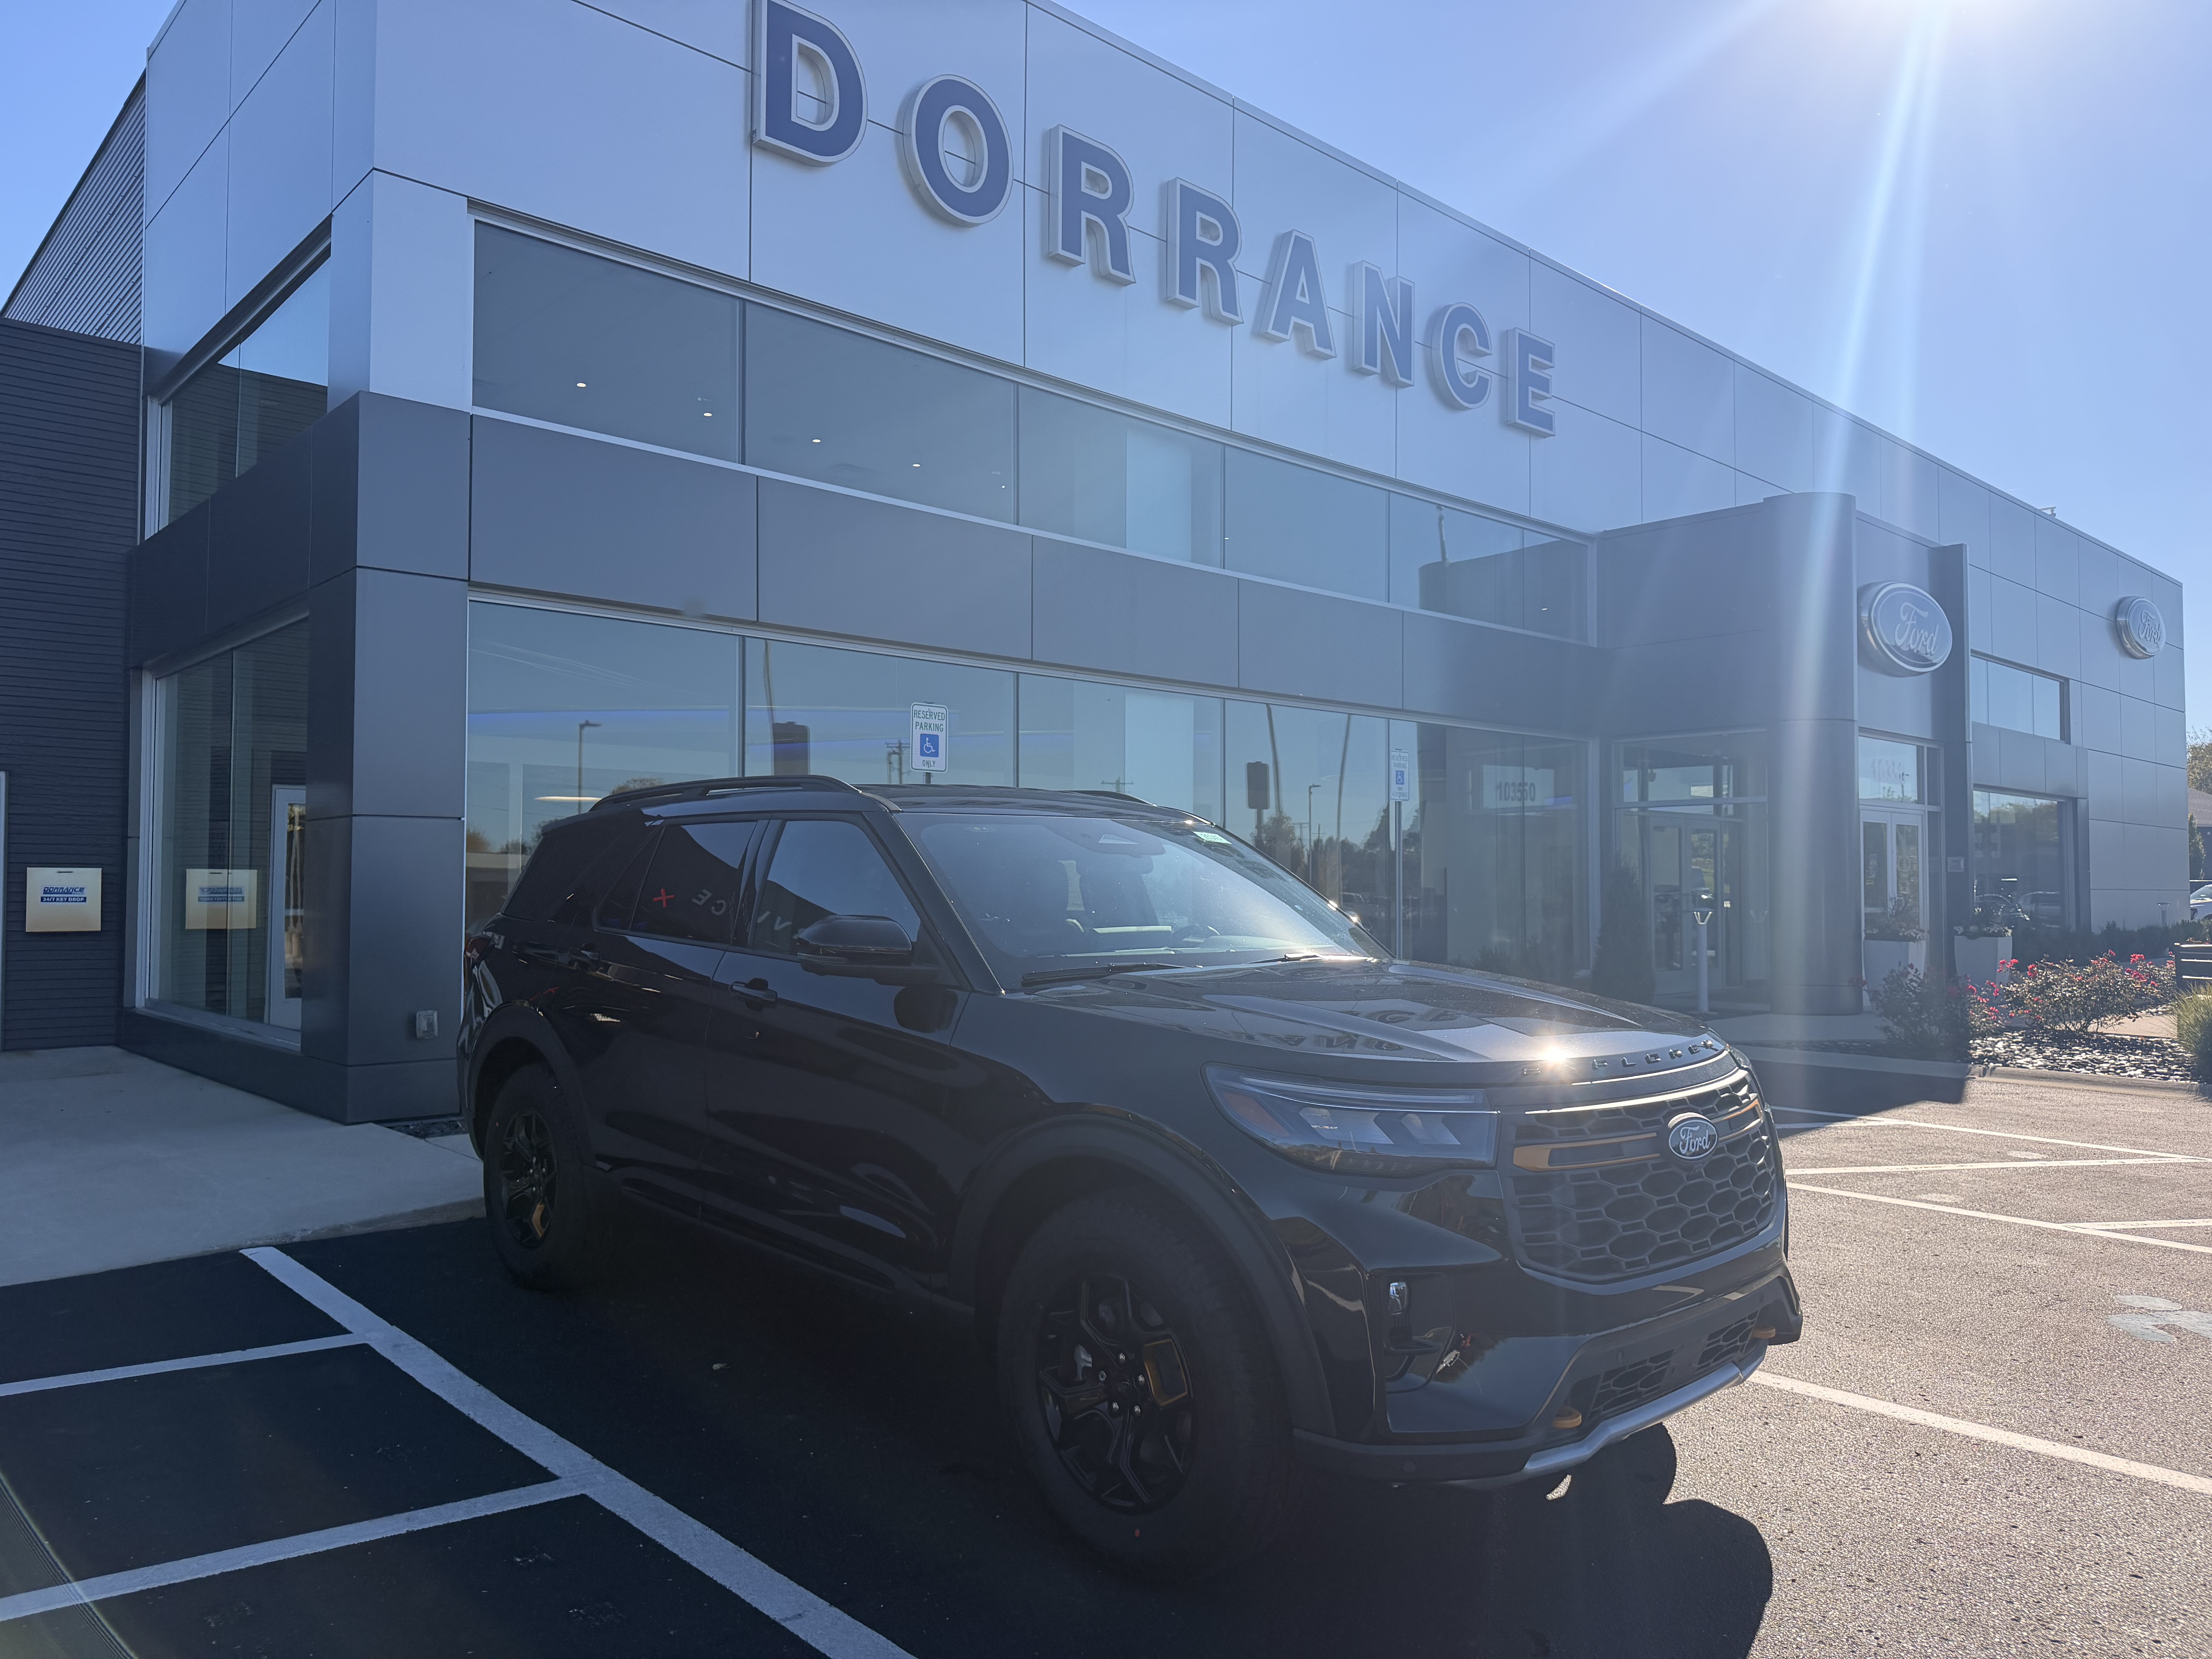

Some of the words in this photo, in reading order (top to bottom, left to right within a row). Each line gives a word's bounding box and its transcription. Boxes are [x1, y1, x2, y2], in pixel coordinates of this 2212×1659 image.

[752, 0, 1555, 438] DORRANCE
[1895, 602, 1939, 656] Ford
[2138, 610, 2161, 645] Ford
[914, 709, 945, 721] RESERVED
[915, 721, 943, 732] PARKING
[1521, 1039, 1714, 1075] EPLORER
[1679, 1125, 1710, 1154] Ford
